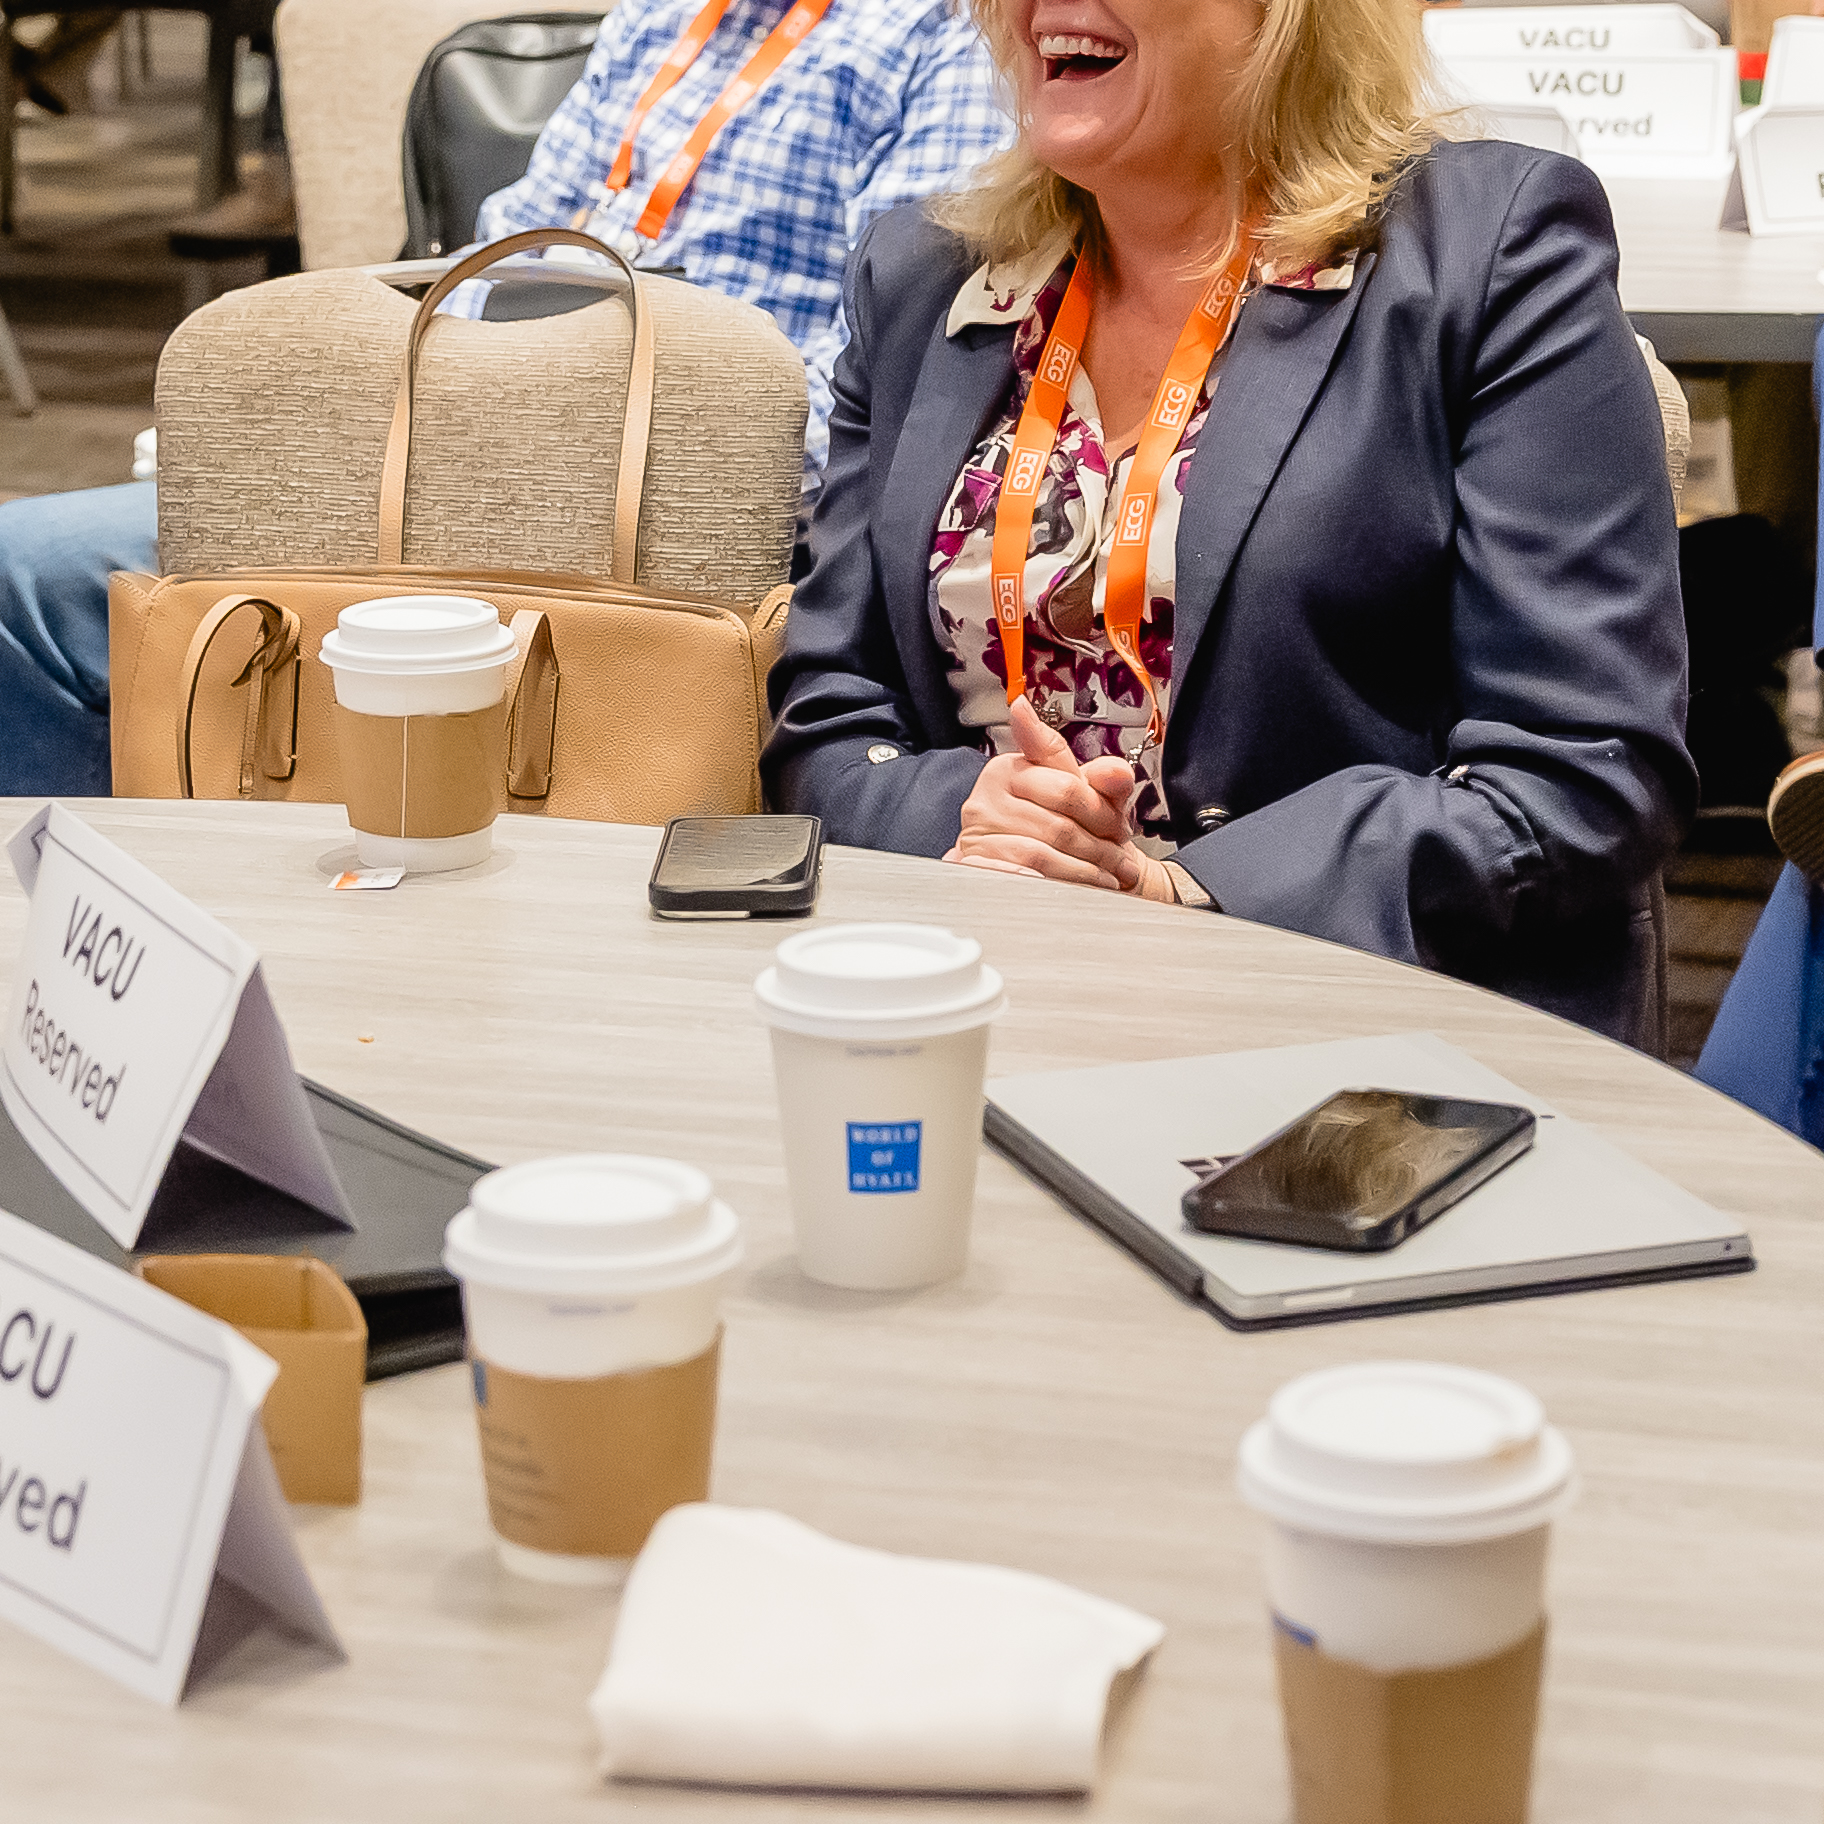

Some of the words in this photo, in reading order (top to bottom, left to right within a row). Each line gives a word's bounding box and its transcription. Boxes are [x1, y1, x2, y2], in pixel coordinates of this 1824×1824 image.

[1518, 28, 1610, 50] VACU
[1528, 70, 1625, 96] VACU
[1578, 112, 1652, 136] rved
[1207, 277, 1235, 318] ECG
[1046, 344, 1072, 383] ECG
[1158, 384, 1188, 426] ECG
[1012, 452, 1040, 490] ECG
[1124, 498, 1146, 542] ECG
[1000, 580, 1016, 622] ECG
[61, 894, 147, 1002] VACU
[21, 980, 127, 1124] Reserved
